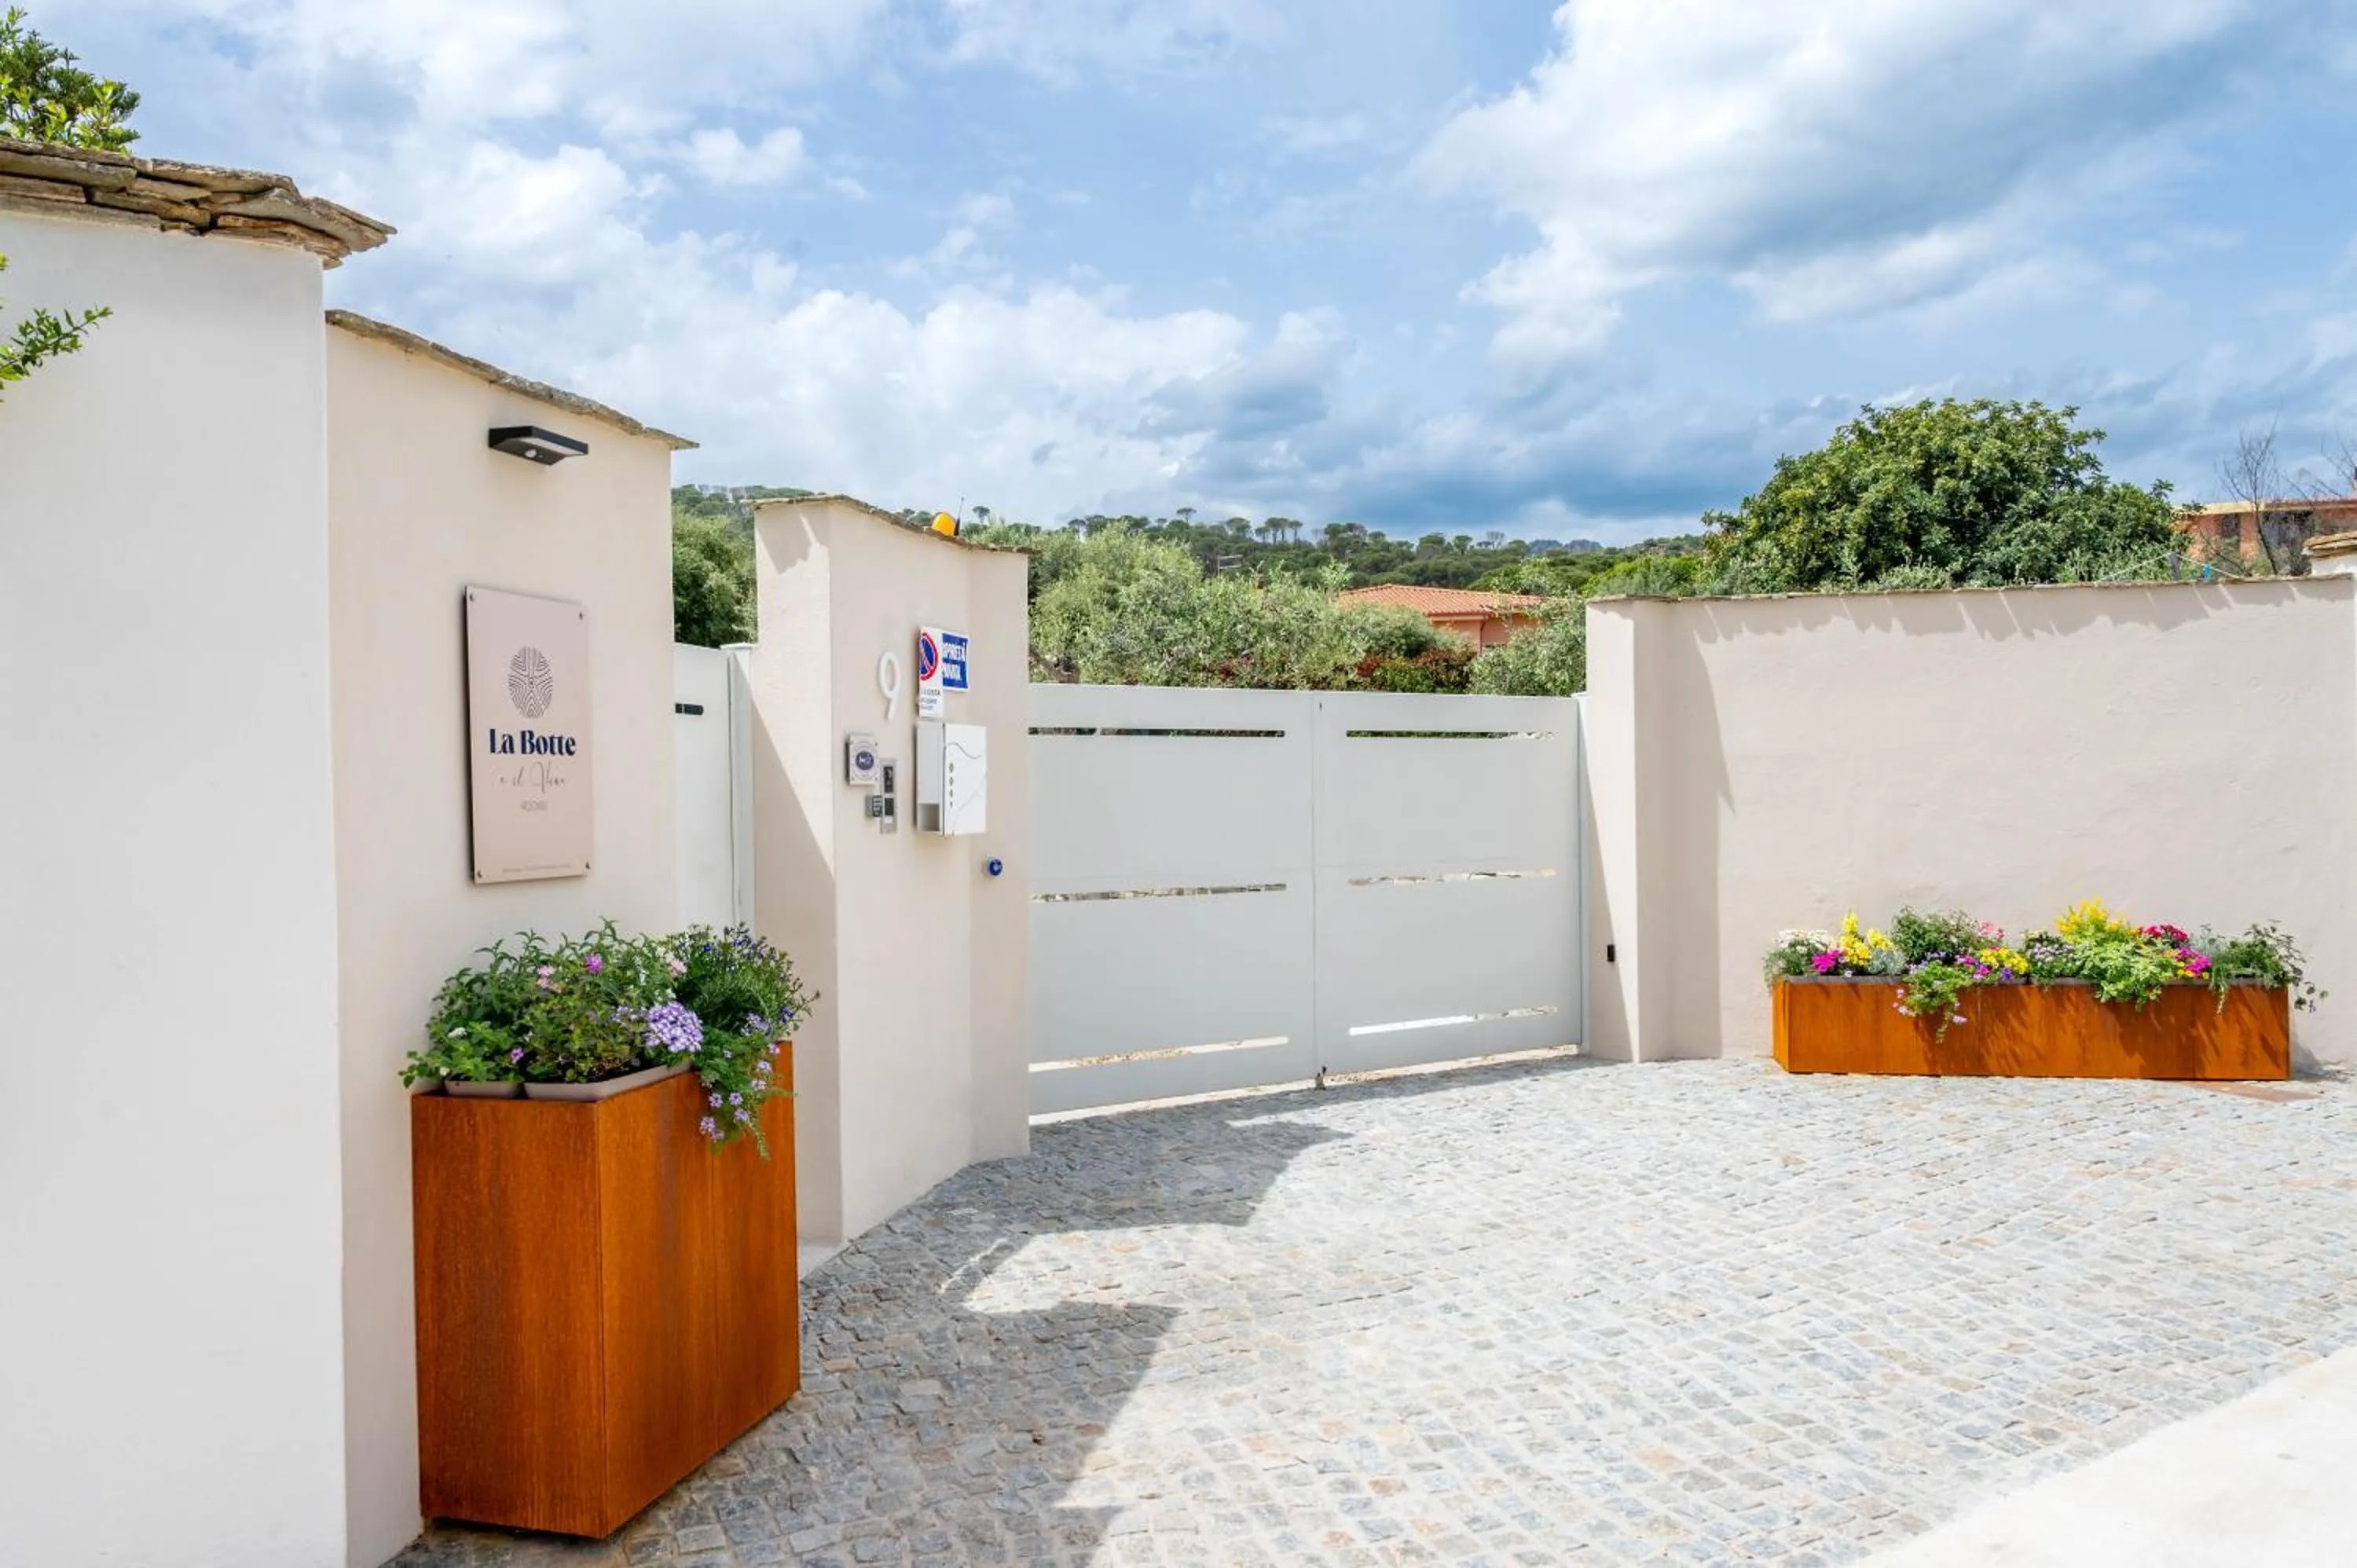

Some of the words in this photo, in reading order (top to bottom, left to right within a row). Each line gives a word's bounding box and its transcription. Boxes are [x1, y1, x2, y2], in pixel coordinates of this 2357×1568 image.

[878, 651, 901, 720] 9
[489, 728, 515, 754] La
[520, 730, 576, 756] Botte
